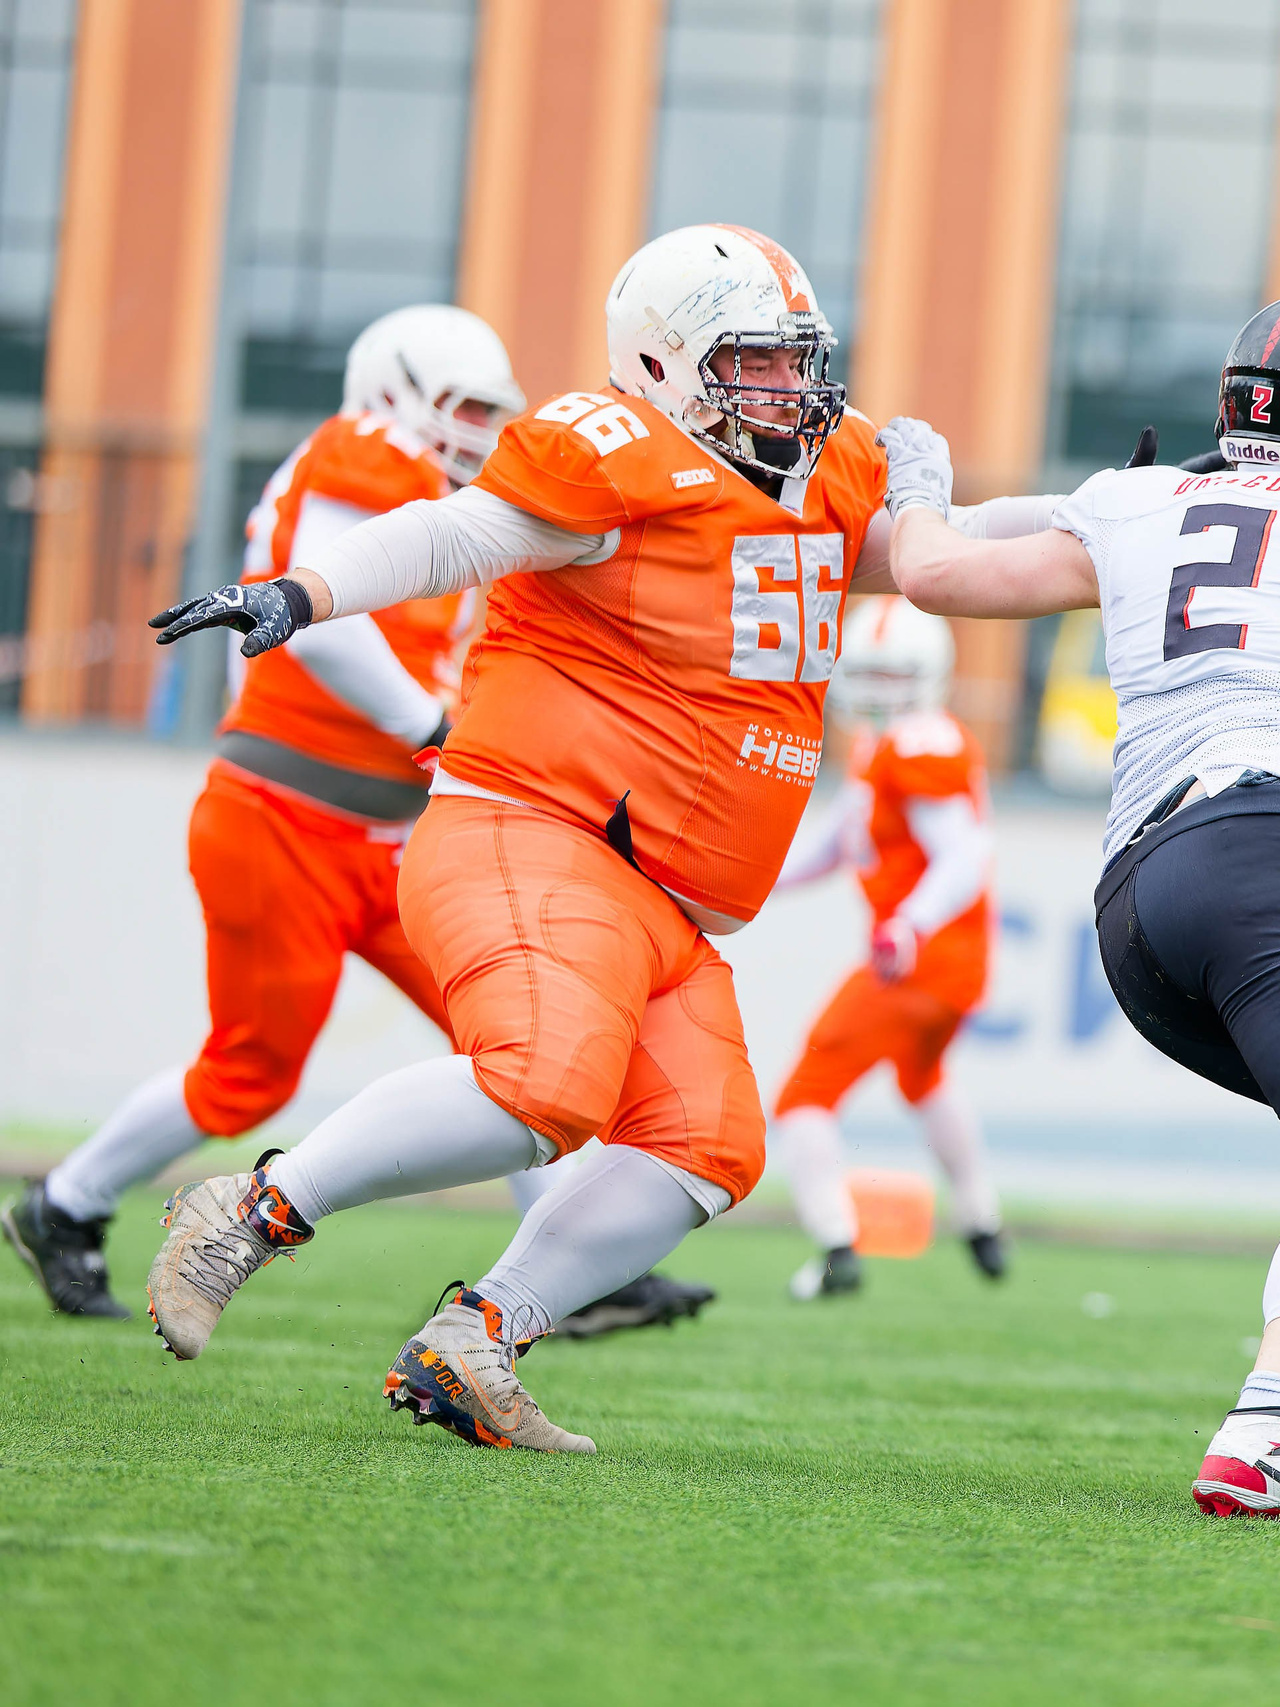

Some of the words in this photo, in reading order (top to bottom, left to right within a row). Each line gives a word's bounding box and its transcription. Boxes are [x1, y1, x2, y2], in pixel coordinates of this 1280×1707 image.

[534, 392, 650, 458] 66
[1250, 384, 1274, 424] 2
[729, 532, 845, 683] 66
[1163, 503, 1277, 662] 2
